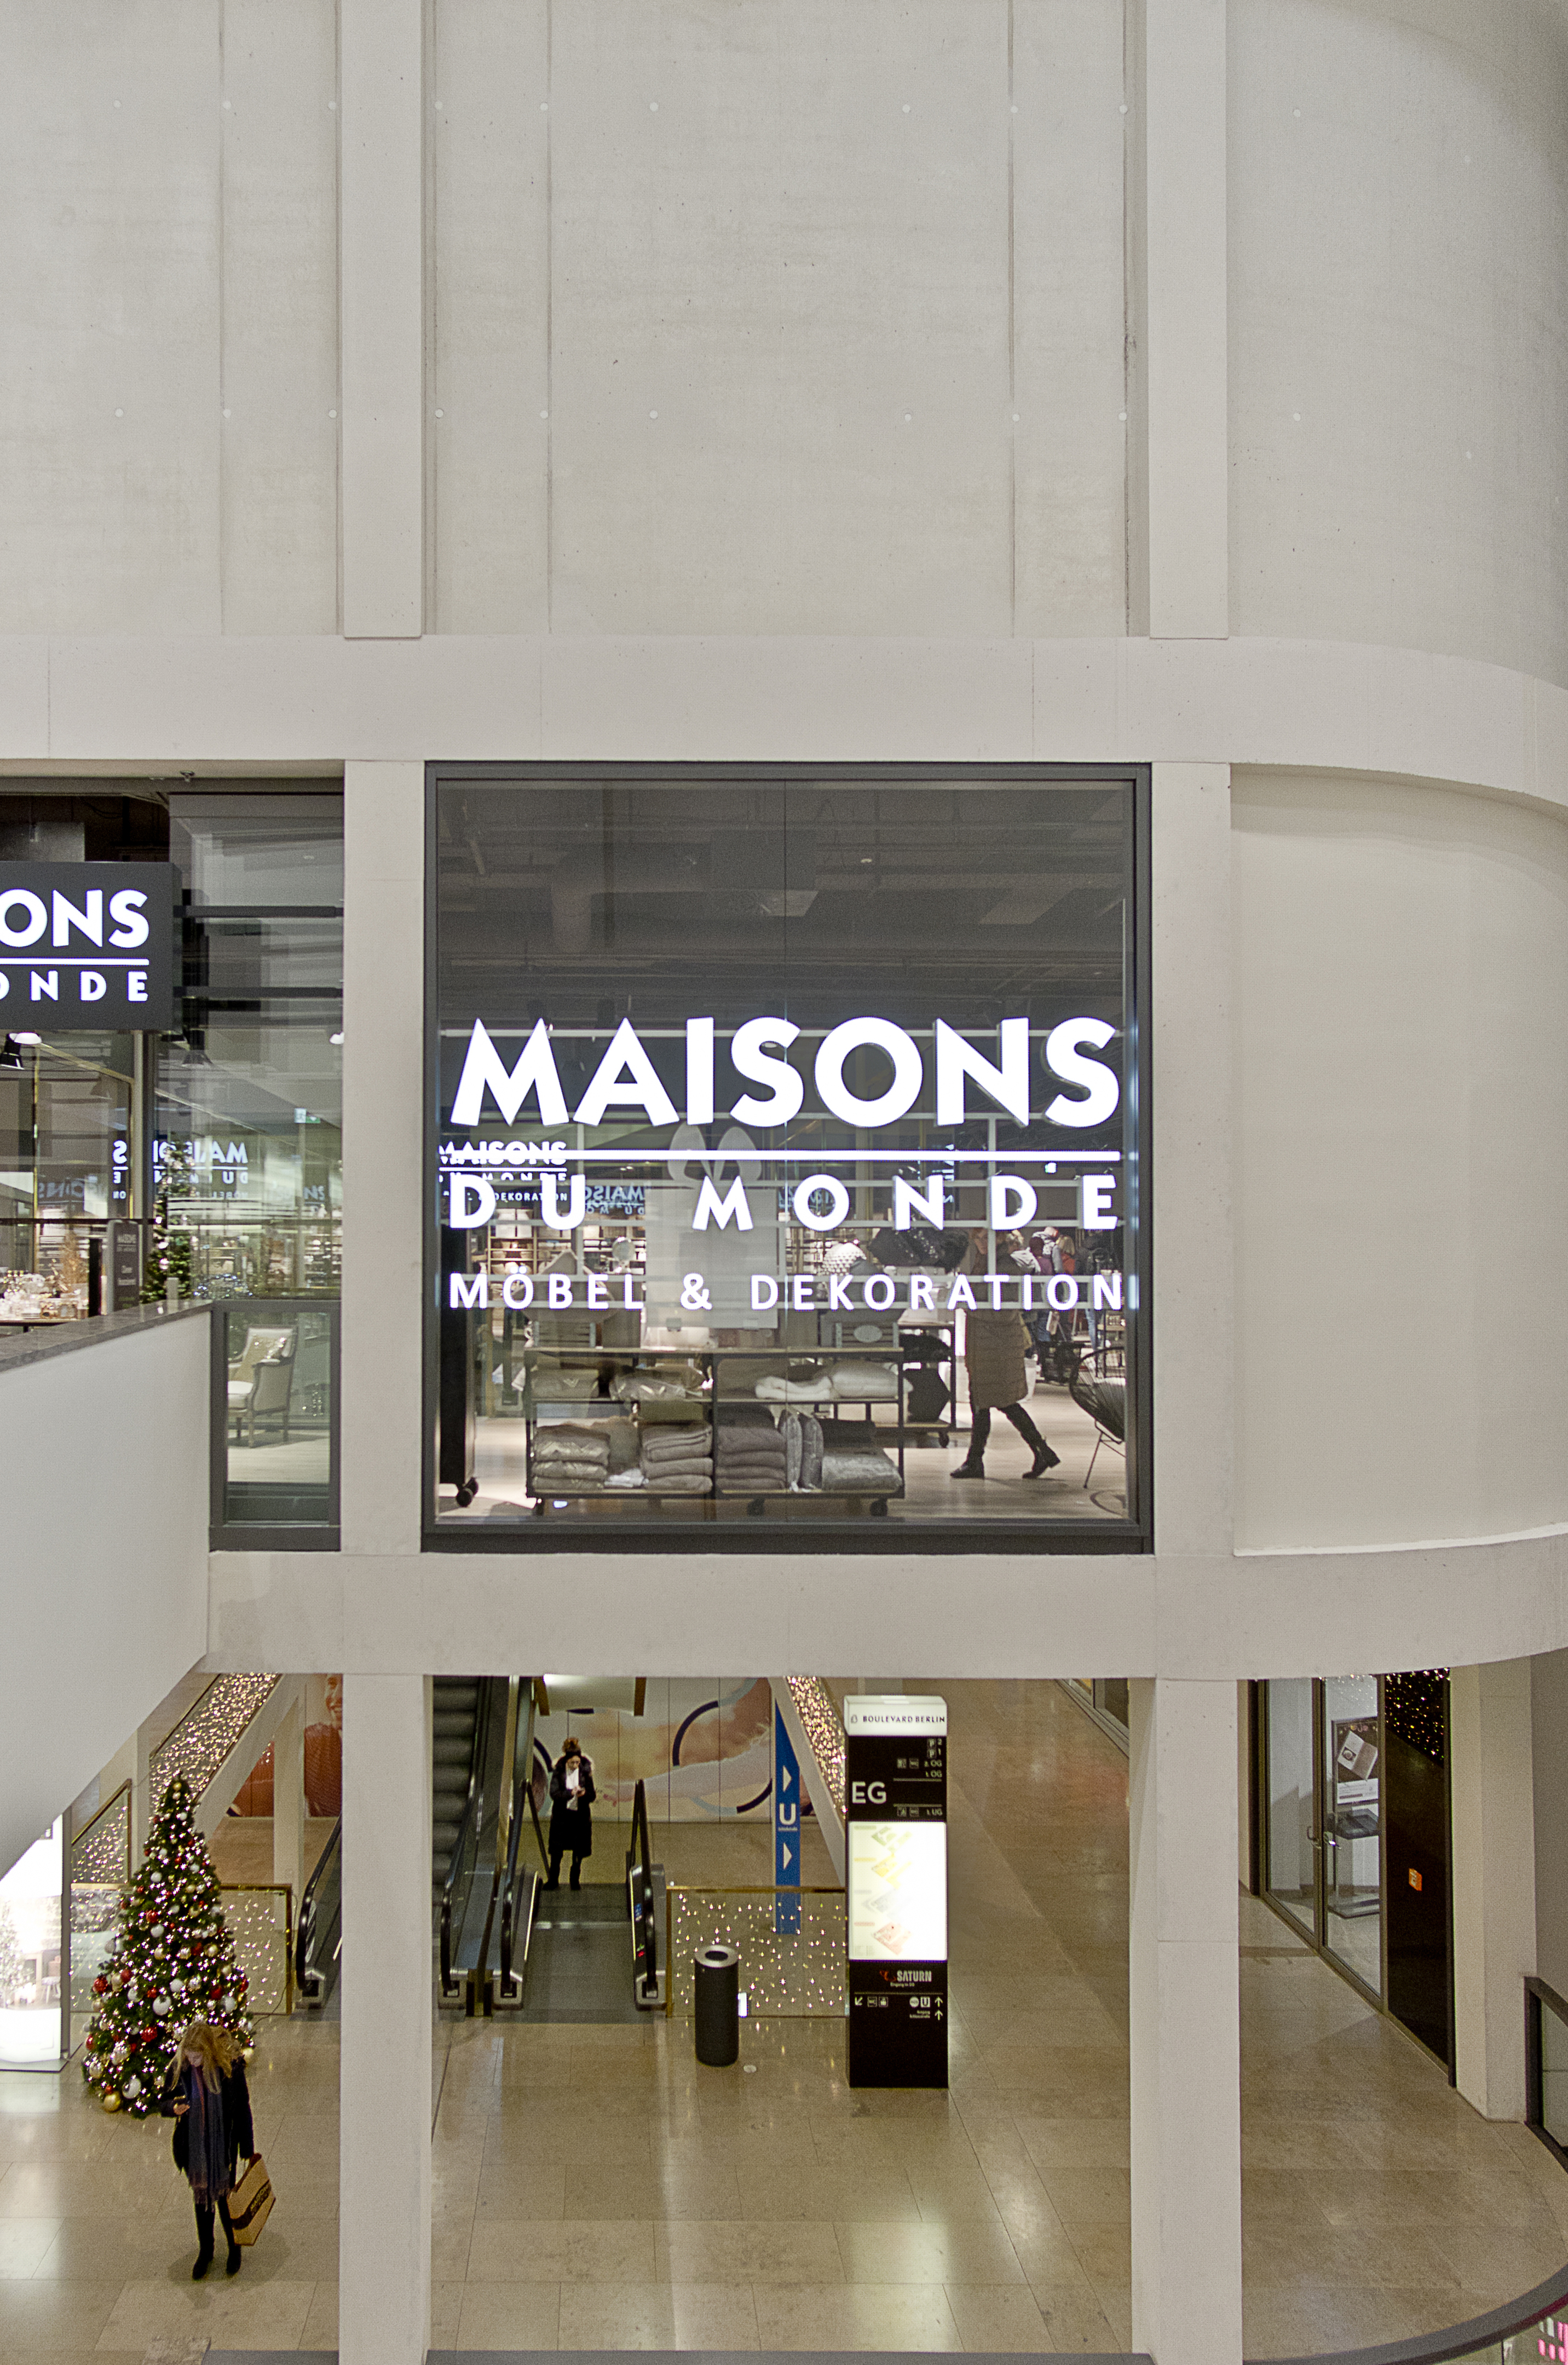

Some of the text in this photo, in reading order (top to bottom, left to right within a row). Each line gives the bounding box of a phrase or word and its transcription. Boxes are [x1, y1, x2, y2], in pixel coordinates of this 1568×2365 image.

[451, 1017, 1119, 1127] MAISONS
[449, 1172, 1117, 1231] DU MONDE
[450, 1265, 1121, 1311] MÖBEL & DEKORATION
[851, 1781, 887, 1804] EG
[779, 1803, 796, 1825] U
[896, 1970, 932, 1982] SATURN
